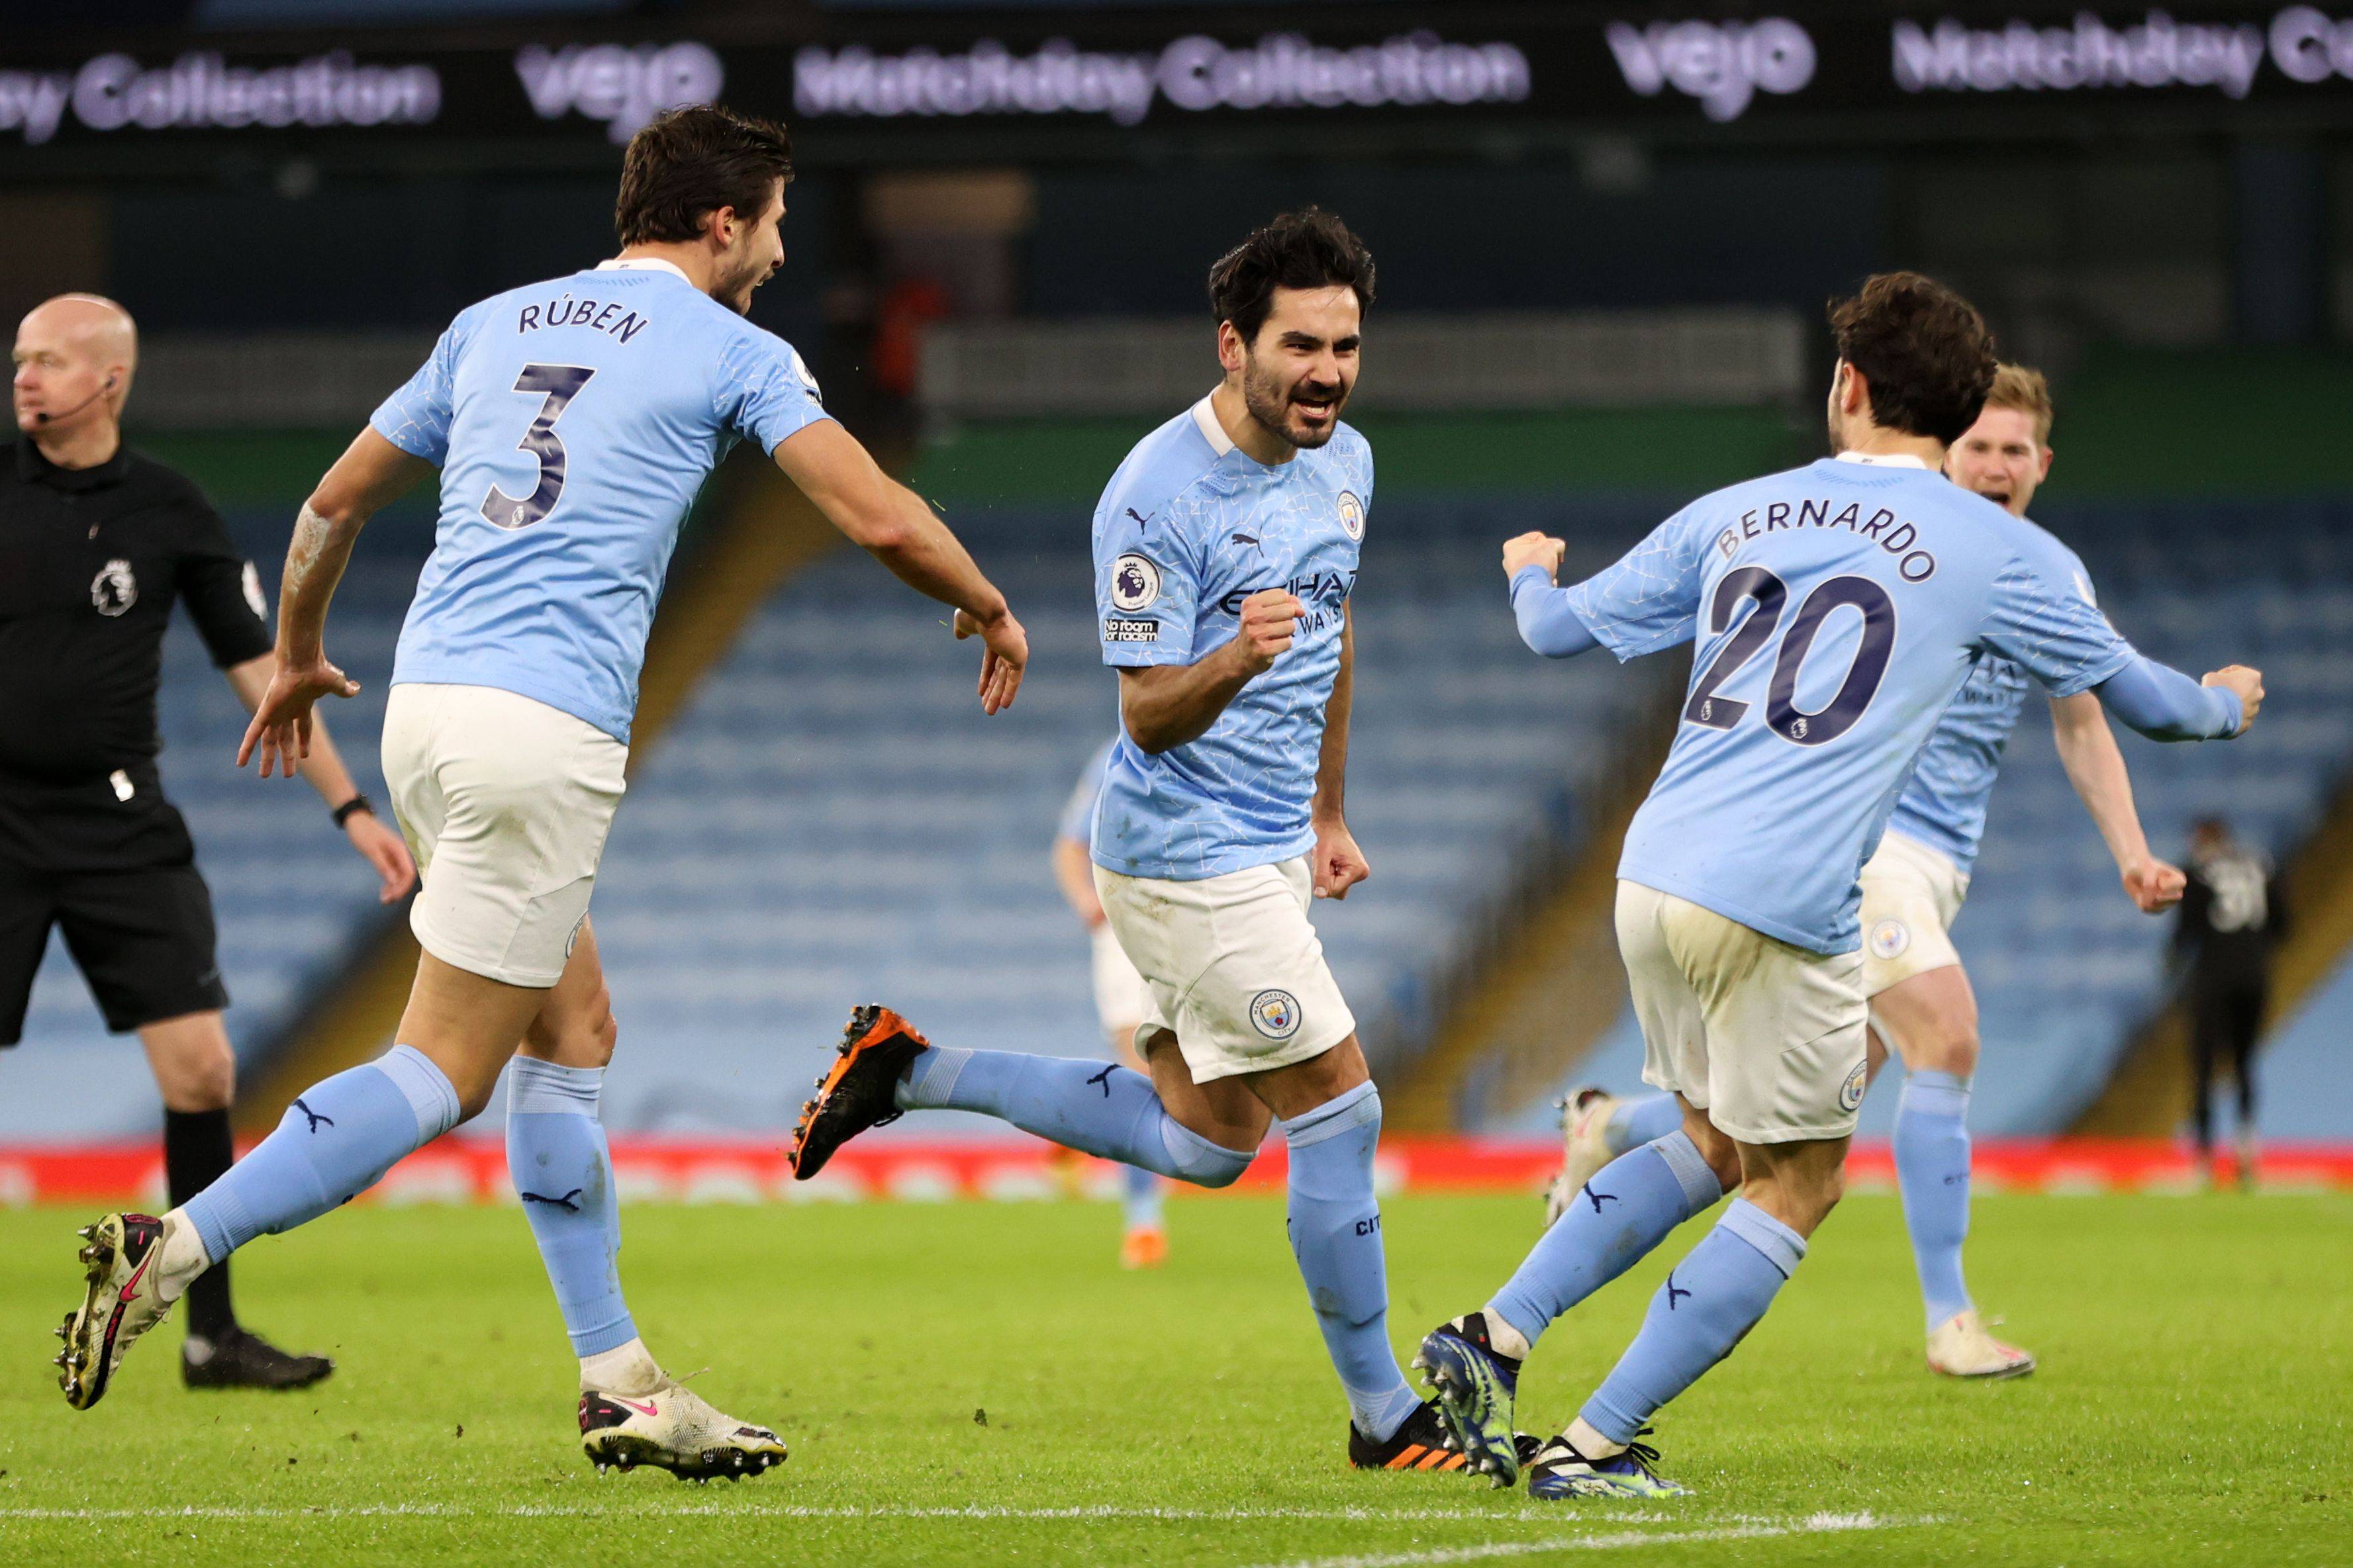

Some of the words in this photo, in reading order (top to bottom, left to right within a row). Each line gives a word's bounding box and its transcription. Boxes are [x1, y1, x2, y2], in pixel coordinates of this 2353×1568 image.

[70, 50, 441, 130] Collection
[794, 36, 1156, 126] Matchday
[1157, 30, 1530, 111] Collection
[1892, 10, 2264, 99] Matchday
[519, 293, 648, 346] RÚBEN
[480, 363, 597, 530] 3
[1718, 499, 1935, 584] BERNARDO
[1104, 620, 1119, 633] No
[1120, 621, 1153, 633] room
[1104, 631, 1118, 642] for
[1119, 631, 1157, 642] racism
[1685, 566, 1898, 747] 20
[1254, 993, 1290, 1015] MANCHESTER
[1277, 1027, 1292, 1037] CITY
